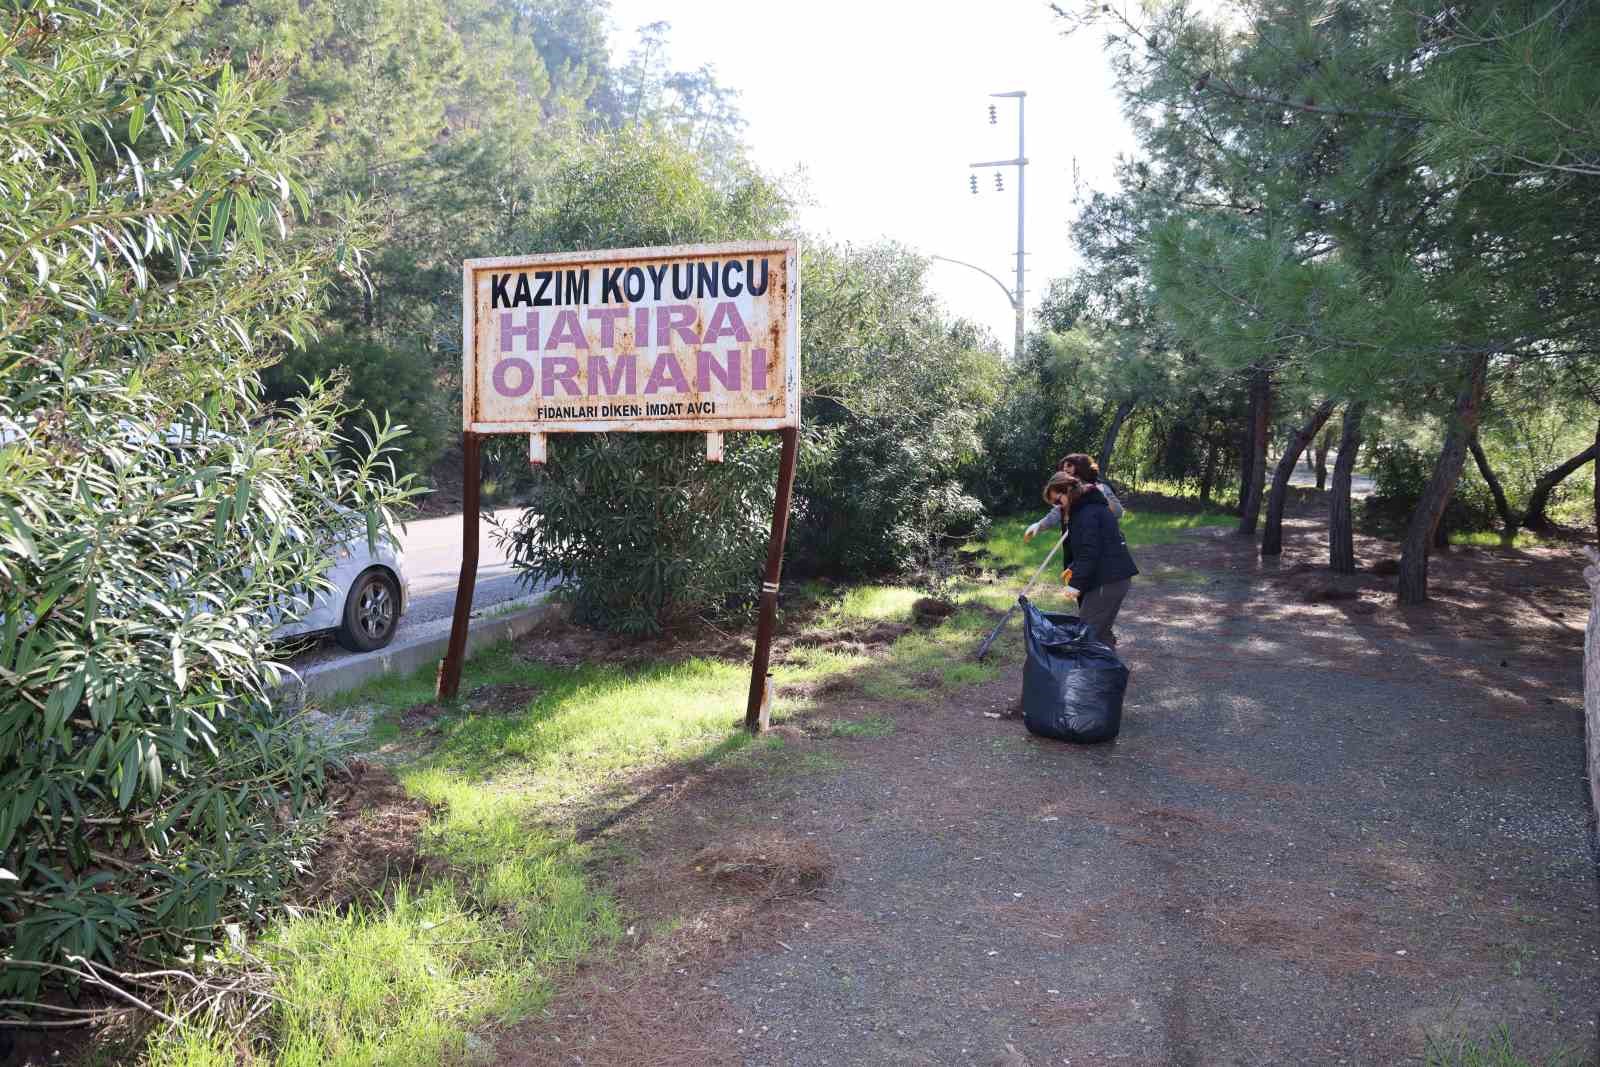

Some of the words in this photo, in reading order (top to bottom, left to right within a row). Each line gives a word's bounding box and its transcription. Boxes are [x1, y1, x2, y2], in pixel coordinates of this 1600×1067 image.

[491, 269, 590, 309] KAZIM
[601, 258, 769, 304] KOYUNCU
[500, 302, 753, 352] HATIRA
[491, 348, 768, 398] ORMANI
[537, 404, 598, 419] FİDANLARI
[601, 402, 642, 418] DİKEN:
[645, 401, 683, 416] İMDAT
[686, 401, 716, 415] AVCI
